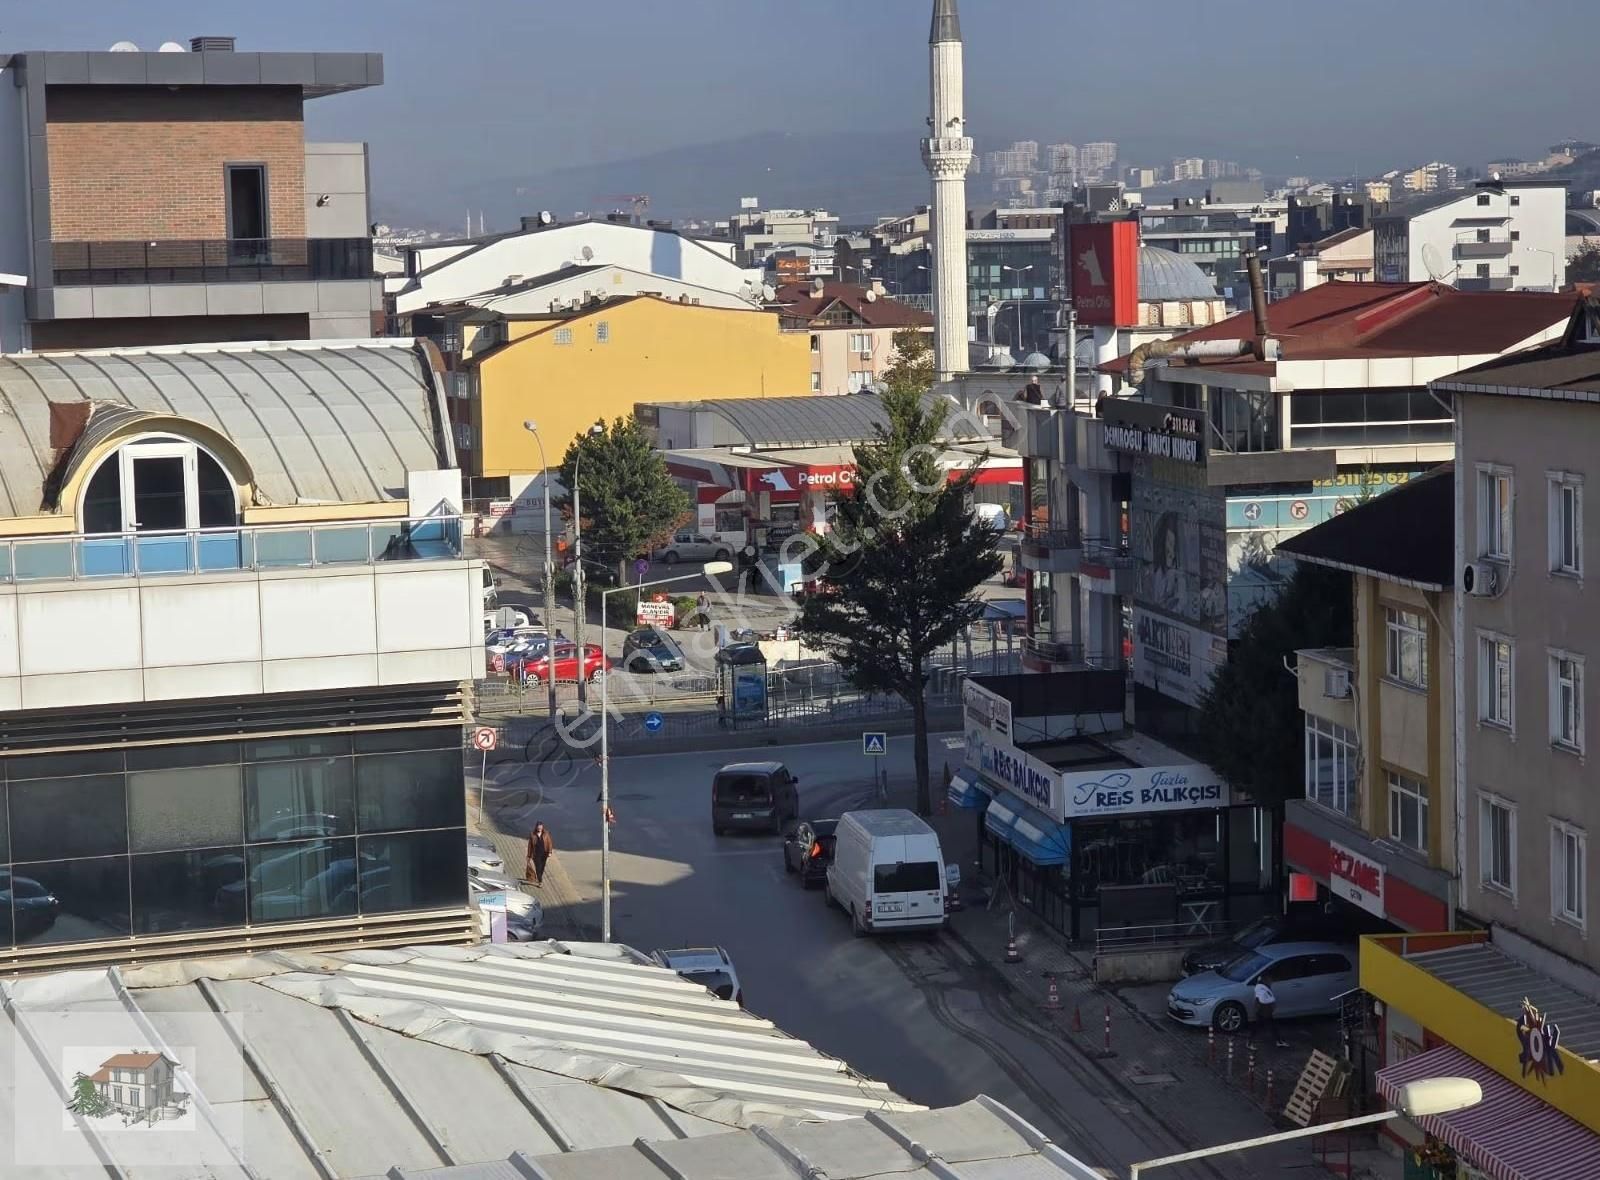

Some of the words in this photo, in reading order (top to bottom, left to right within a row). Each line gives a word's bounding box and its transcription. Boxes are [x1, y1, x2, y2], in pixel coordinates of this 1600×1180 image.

[798, 471, 836, 485] Petrol
[1386, 472, 1409, 486] 62
[1141, 785, 1221, 804] BALIKÇISI
